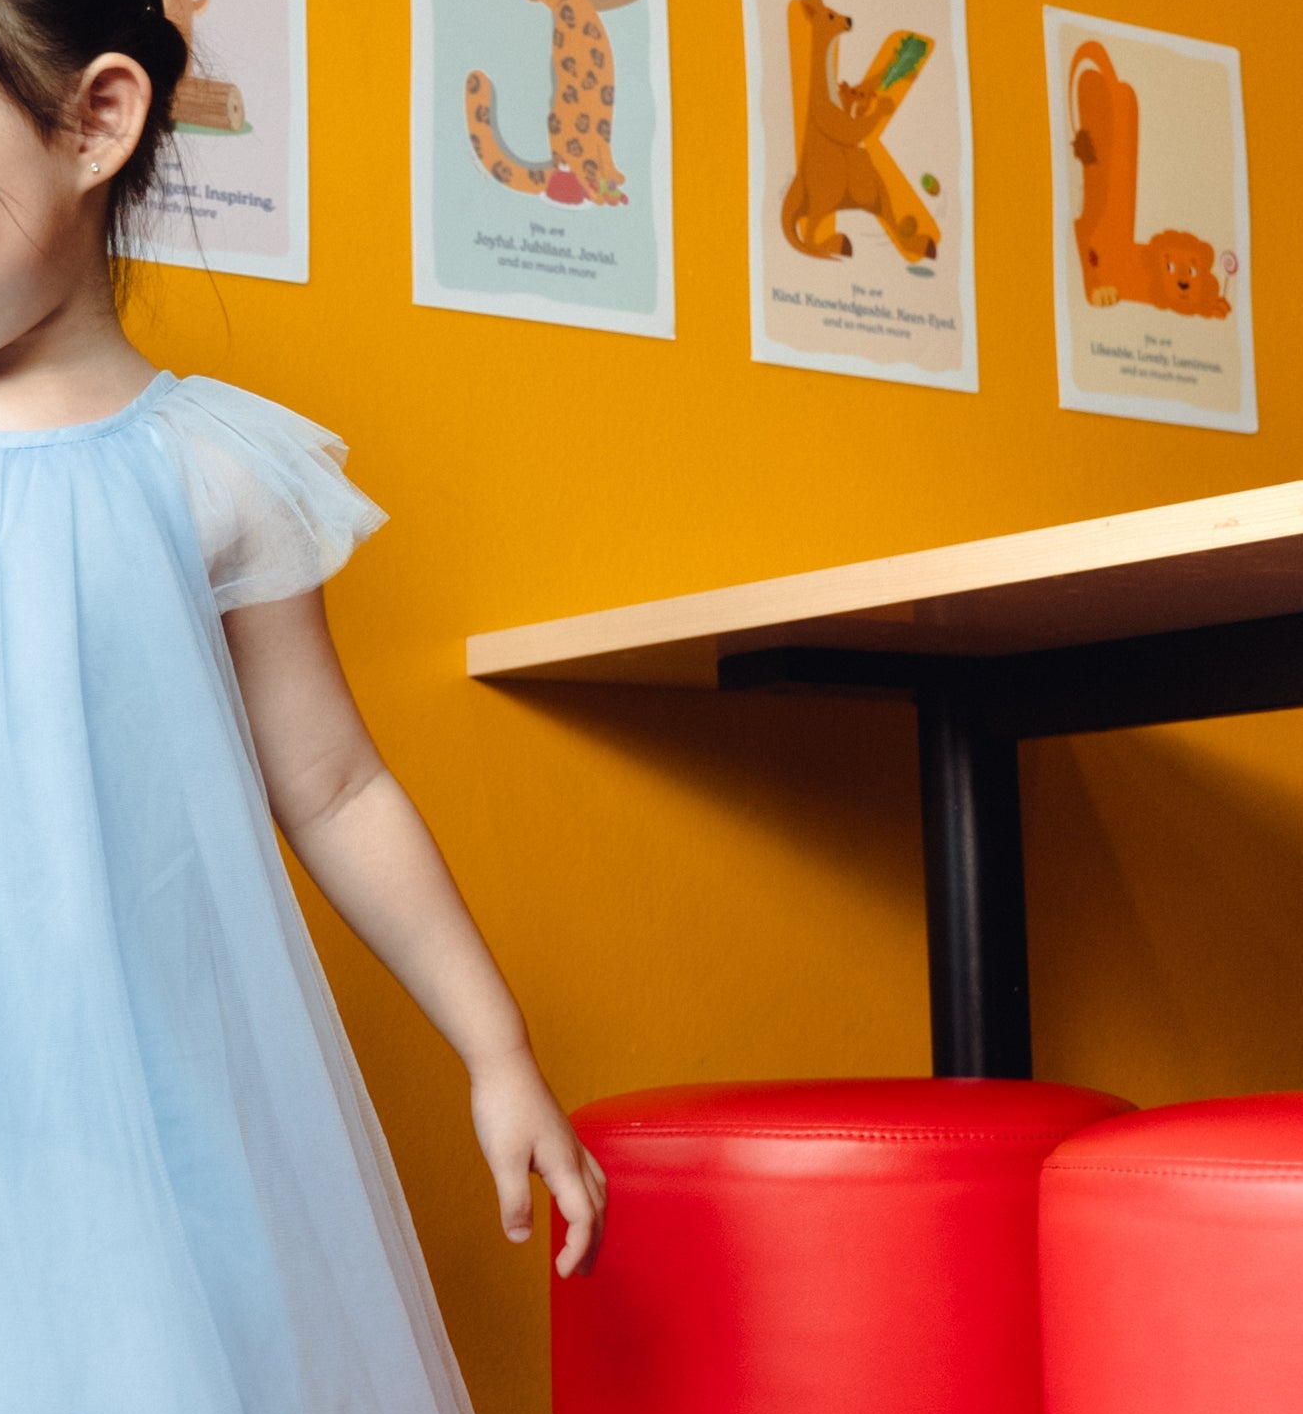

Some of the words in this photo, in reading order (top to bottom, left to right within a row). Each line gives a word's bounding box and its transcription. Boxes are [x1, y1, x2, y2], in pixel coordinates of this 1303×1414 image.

[205, 184, 275, 212] Inspiring.
[474, 232, 515, 251] Joyful.
[520, 239, 576, 259] Jubilant.
[579, 249, 618, 266] Jovial.
[498, 256, 519, 268] and
[521, 260, 533, 269] so
[536, 261, 566, 274] much
[568, 268, 596, 279] more
